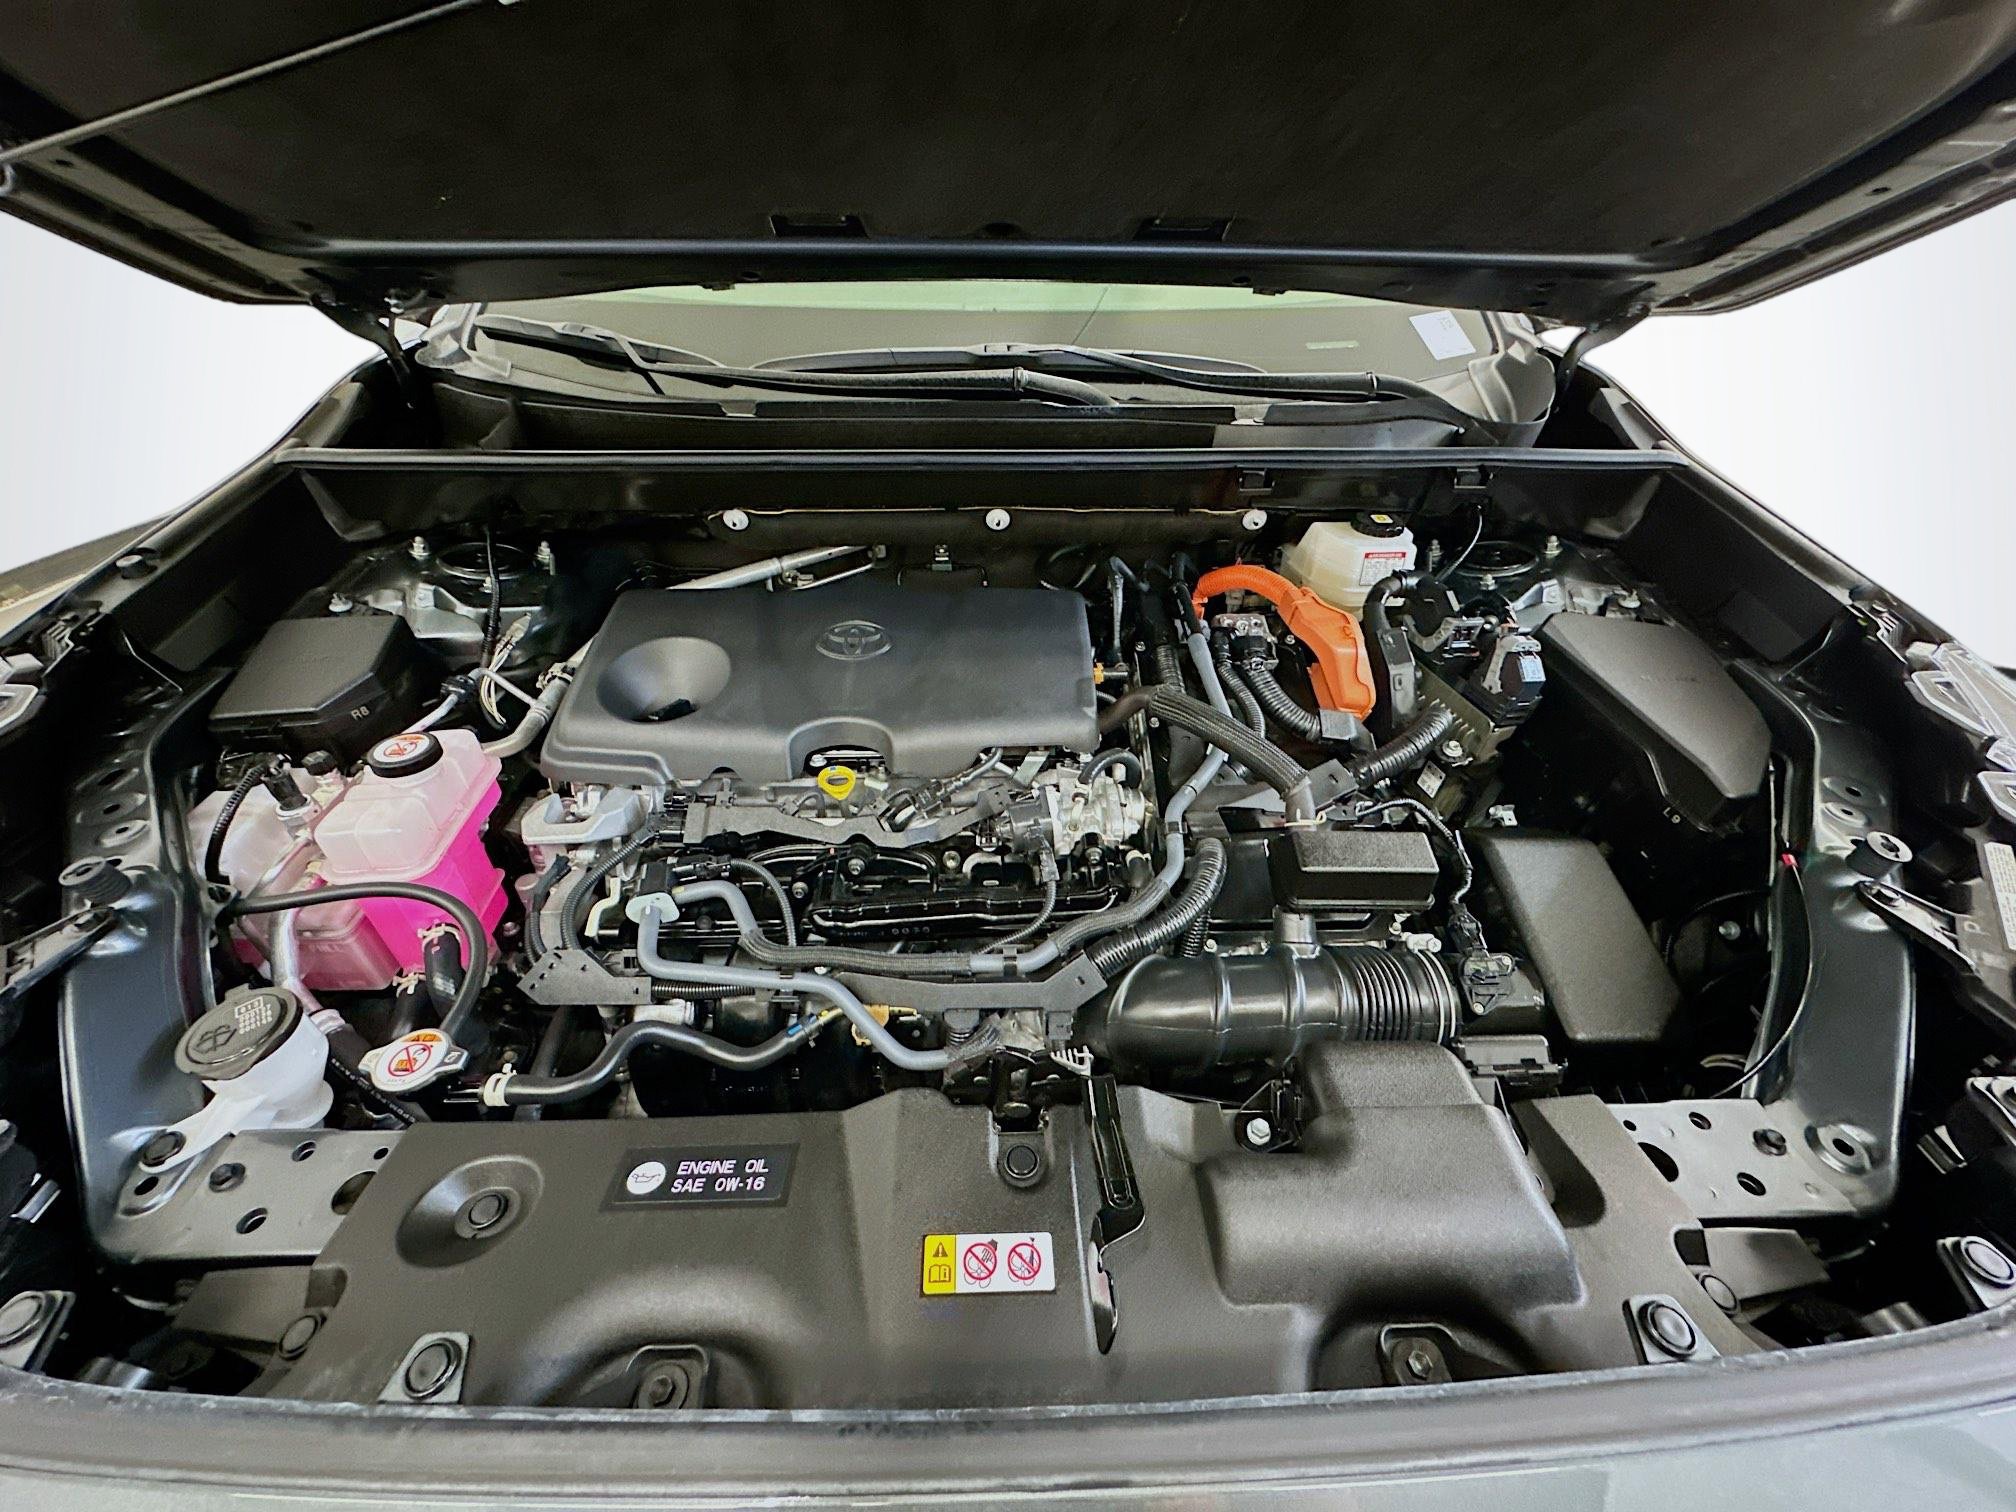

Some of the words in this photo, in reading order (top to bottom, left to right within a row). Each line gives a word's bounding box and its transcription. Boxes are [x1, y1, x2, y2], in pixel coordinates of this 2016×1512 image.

[676, 1160, 737, 1175] ENGINE
[744, 1157, 769, 1173] OIL
[670, 1178, 706, 1193] SAE
